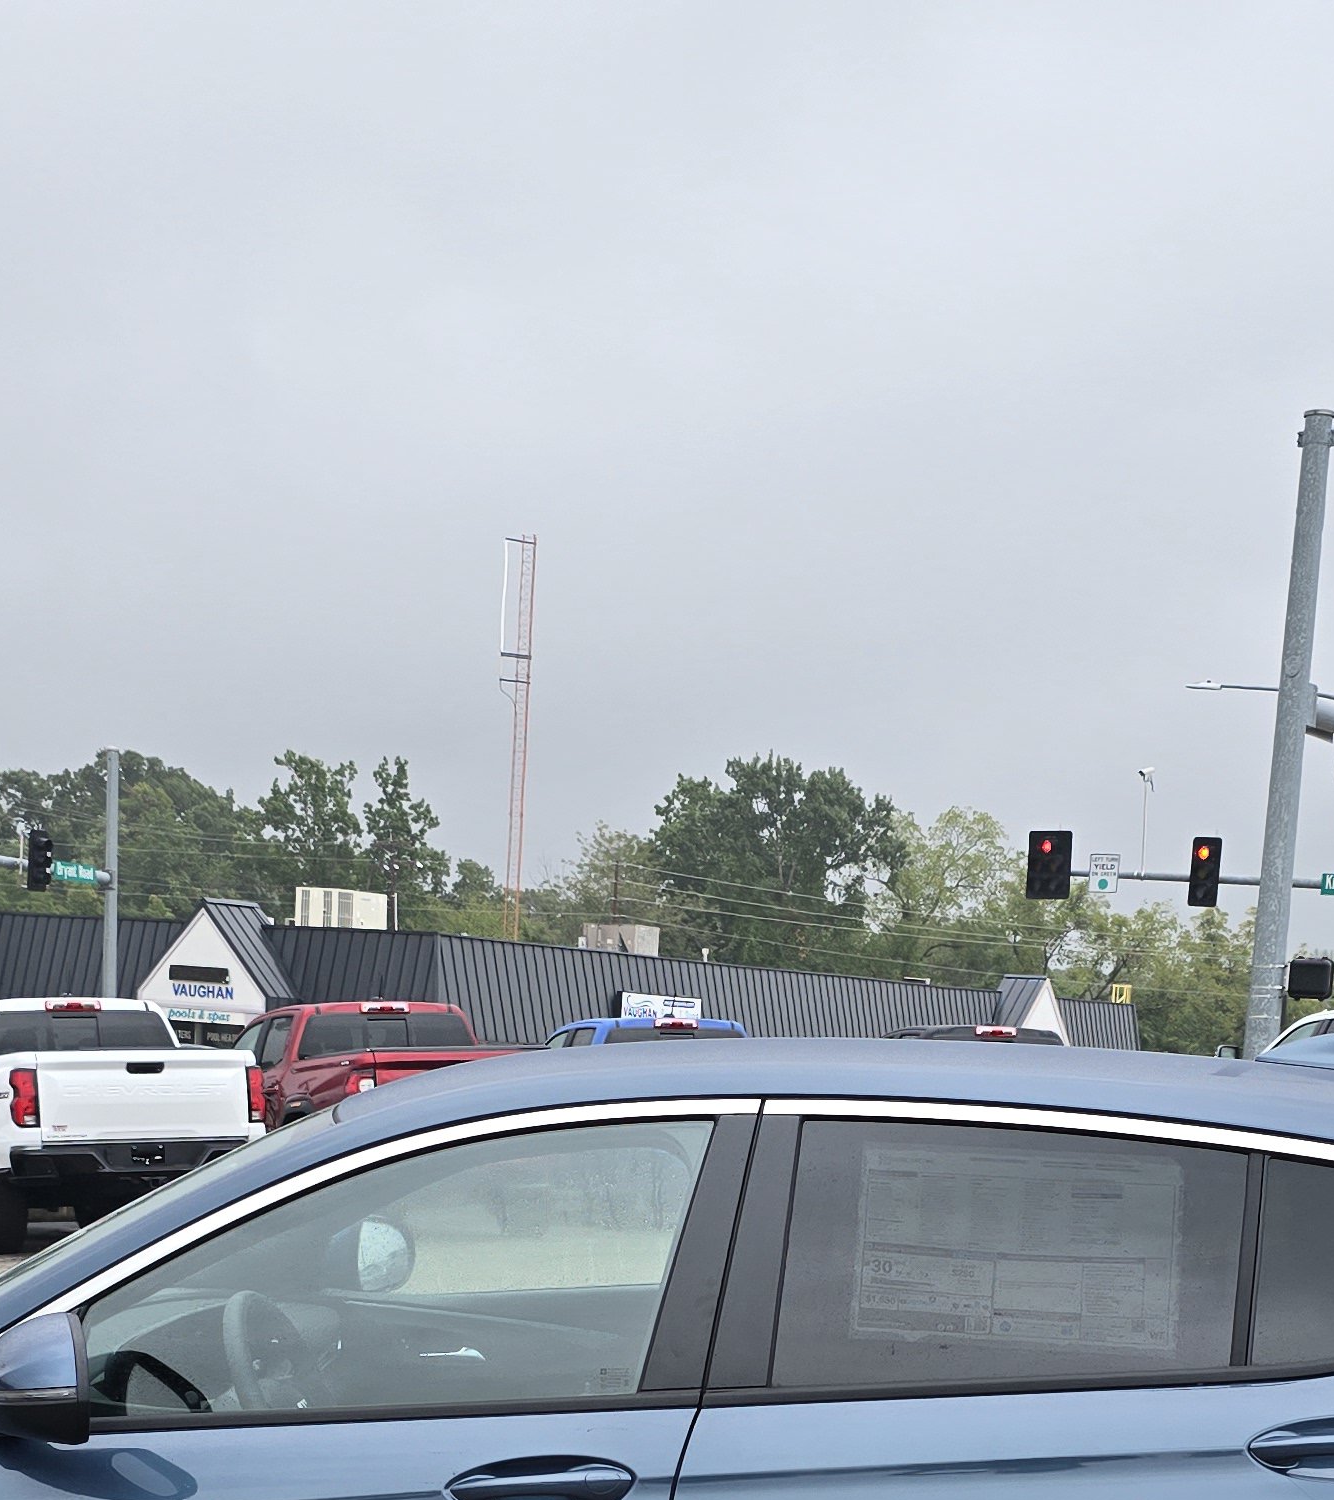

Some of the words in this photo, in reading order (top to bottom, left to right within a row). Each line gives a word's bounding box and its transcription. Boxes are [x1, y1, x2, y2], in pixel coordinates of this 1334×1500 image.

[57, 862, 77, 879] Bryant
[78, 865, 94, 880] Road
[172, 982, 234, 1000] VAUGHAN
[167, 1008, 195, 1020] pools
[208, 1012, 230, 1023] spas
[624, 1007, 657, 1018] VAUGHAN
